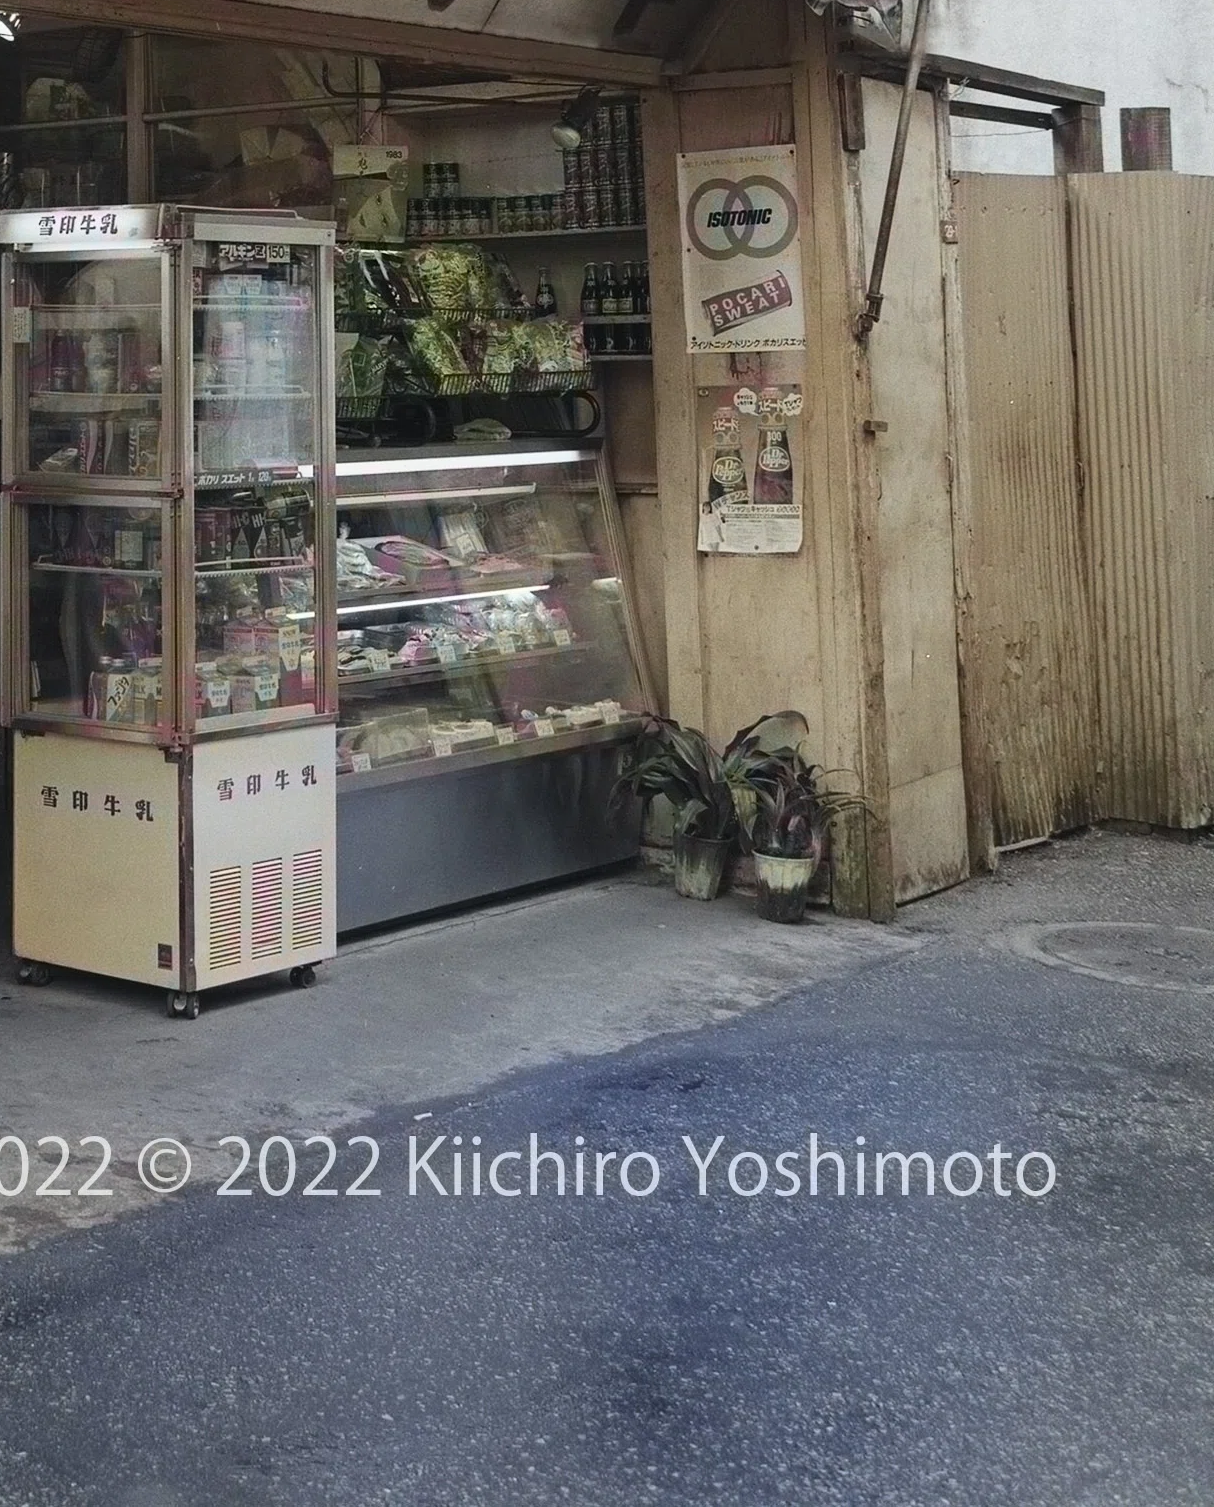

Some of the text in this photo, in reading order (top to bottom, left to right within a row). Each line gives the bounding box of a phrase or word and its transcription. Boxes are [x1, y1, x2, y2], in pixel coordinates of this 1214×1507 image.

[385, 150, 403, 159] 1983
[38, 213, 119, 237] 雪印牛乳
[706, 207, 773, 229] ISOTONIC
[709, 274, 786, 316] POCARI
[713, 290, 781, 327] SWEAT
[715, 464, 744, 481] Pepper
[725, 460, 738, 469] Dr
[217, 764, 318, 802] 雪印牛乳
[40, 784, 155, 822] 雪印牛乳
